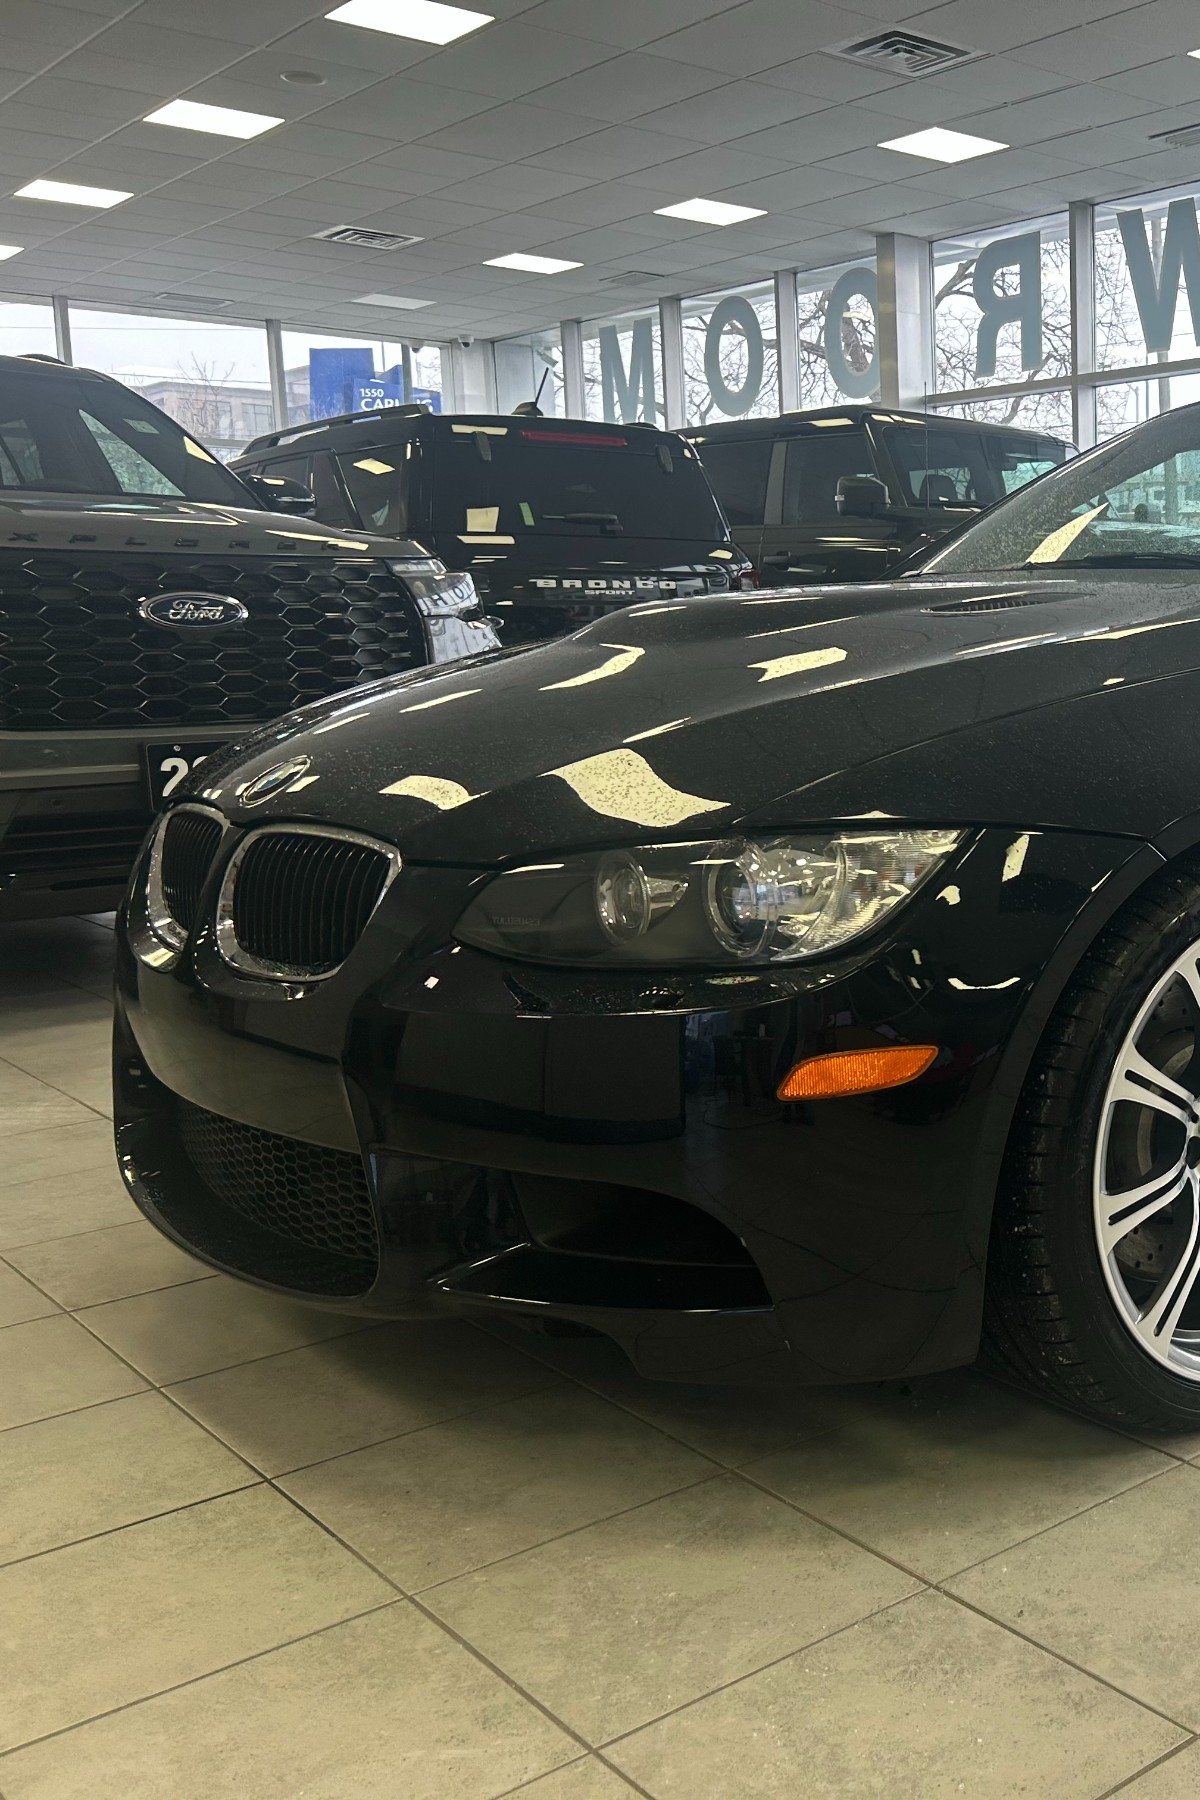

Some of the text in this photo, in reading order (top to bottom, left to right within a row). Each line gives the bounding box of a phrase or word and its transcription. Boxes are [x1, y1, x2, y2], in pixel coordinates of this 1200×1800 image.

[360, 388, 384, 397] 1550
[536, 578, 677, 589] BRONCO
[168, 599, 225, 620] Ford
